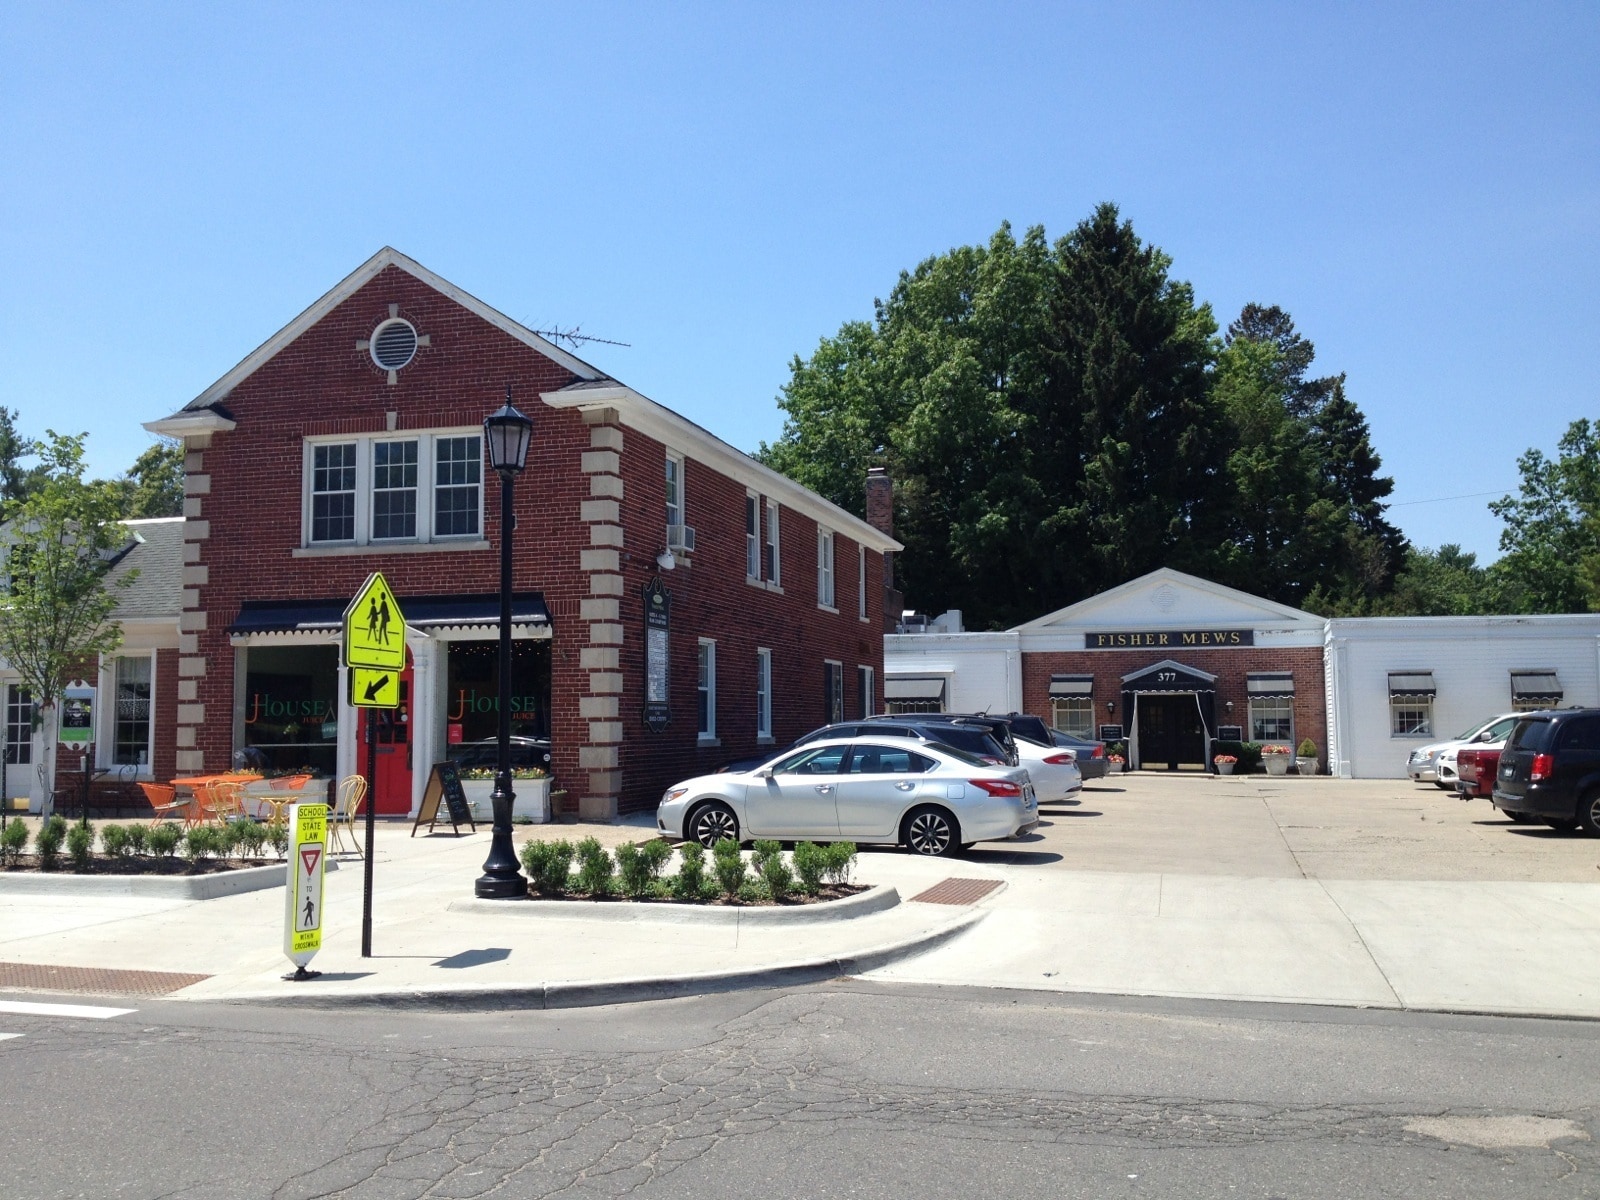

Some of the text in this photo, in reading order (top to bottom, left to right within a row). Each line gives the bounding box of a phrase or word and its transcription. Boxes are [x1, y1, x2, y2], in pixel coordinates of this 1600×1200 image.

[1098, 632, 1240, 646] FISHER MEWS
[1157, 673, 1176, 682] 377
[300, 807, 325, 817] SCHOOL
[303, 822, 321, 831] STATE
[305, 832, 318, 841] LAW
[294, 940, 319, 951] CROSSWALK
